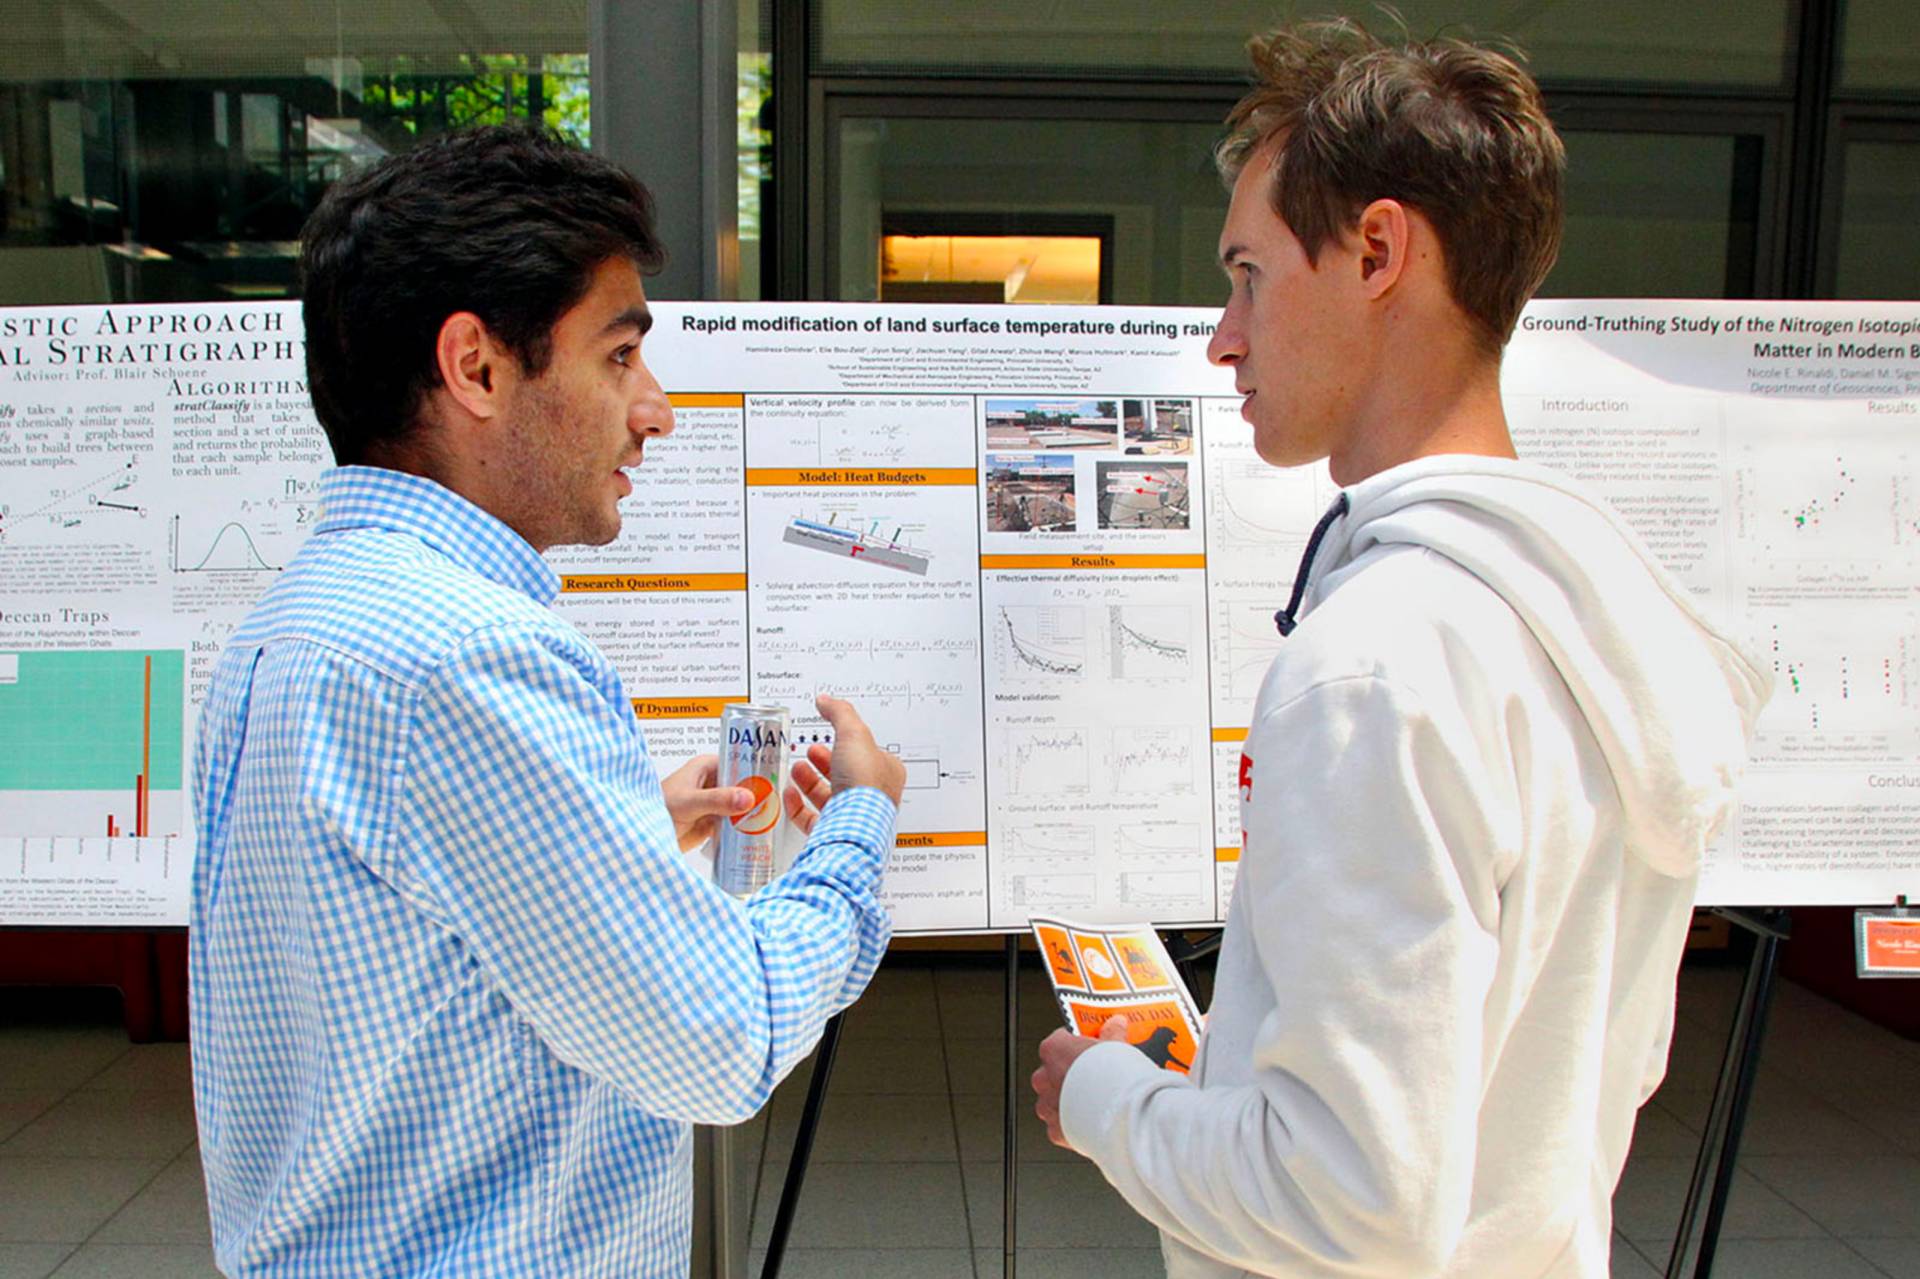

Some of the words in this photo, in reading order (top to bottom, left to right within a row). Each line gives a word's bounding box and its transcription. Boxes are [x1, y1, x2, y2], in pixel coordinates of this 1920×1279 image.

[4, 317, 78, 336] STIC
[96, 310, 283, 334] APPROACH
[682, 316, 736, 334] Rapid
[742, 316, 859, 332] modification
[864, 316, 882, 332] of
[888, 317, 926, 332] land
[932, 318, 1000, 333] surface
[1006, 319, 1115, 337] temperature
[1121, 320, 1177, 339] during
[1523, 316, 1666, 335] Ground-Truthing
[1671, 316, 1718, 335] Study
[1724, 316, 1744, 332] of
[1747, 318, 1774, 332] the
[1780, 317, 1853, 335] Nitrogen
[49, 339, 309, 364] STRATIGRAPH
[1754, 343, 1811, 357] Matter
[1818, 343, 1832, 357] in
[1838, 344, 1904, 358] Modern
[14, 371, 70, 382] Advisor:
[77, 369, 108, 380] Prof.
[115, 368, 148, 379] Blair
[153, 368, 206, 378] Schoene
[1748, 368, 1781, 378] Nicole
[1841, 368, 1873, 378] Daniel
[1751, 383, 1816, 394] Department
[1819, 383, 1830, 394] of
[27, 405, 55, 414] takes
[85, 405, 121, 413] section
[134, 402, 154, 412] and
[174, 400, 249, 413] stratClassify
[254, 401, 261, 409] is
[750, 399, 783, 407] Vertical
[788, 399, 822, 409] velocity
[827, 399, 856, 408] profile
[901, 399, 911, 407] be
[916, 399, 946, 407] derived
[1542, 399, 1629, 412] Introduction
[1869, 401, 1916, 413] Results
[174, 414, 215, 424] method
[233, 413, 254, 422] that
[272, 412, 300, 422] takes
[750, 409, 763, 417] the
[766, 409, 805, 419] continuity
[16, 417, 73, 430] chemically
[80, 416, 117, 426] similar
[85, 428, 154, 441] graph-based
[174, 427, 211, 436] section
[217, 427, 237, 436] and
[255, 427, 270, 435] set
[275, 425, 287, 435] of
[292, 425, 323, 436] units,
[26, 445, 37, 453] to
[42, 443, 70, 452] build
[76, 444, 102, 452] trees
[108, 442, 153, 451] between
[173, 440, 193, 450] and
[197, 440, 237, 449] returns
[240, 439, 257, 448] the
[261, 437, 321, 452] probability
[31, 456, 77, 468] samples.
[173, 453, 194, 463] that
[201, 452, 226, 462] each
[233, 452, 272, 464] sample
[279, 450, 322, 464] belongs
[173, 466, 183, 476] to
[187, 465, 211, 476] each
[215, 465, 240, 475] unit.
[799, 472, 841, 482] Model:
[845, 473, 874, 482] Heat
[878, 473, 926, 484] Budgets
[762, 491, 801, 499] Important
[1072, 557, 1115, 567] Results
[566, 578, 624, 590] Research
[627, 578, 689, 590] Questions
[1063, 575, 1100, 583] diffusivity
[1121, 574, 1151, 583] droplets
[766, 582, 793, 591] Solving
[797, 582, 869, 590] advection-diffusion
[873, 582, 906, 591] equation
[910, 581, 920, 589] for
[923, 581, 935, 589] the
[567, 597, 603, 606] questions
[607, 596, 620, 604] will
[623, 596, 631, 604] be
[634, 596, 646, 604] the
[649, 596, 668, 604] focus
[766, 593, 811, 602] conjunction
[907, 592, 940, 601] equation
[60, 608, 109, 625] Traps
[192, 641, 219, 651] Both
[192, 657, 208, 665] are
[648, 704, 708, 716] Dynamics
[1033, 716, 1055, 724] depth
[1150, 1007, 1175, 1020] DAY
